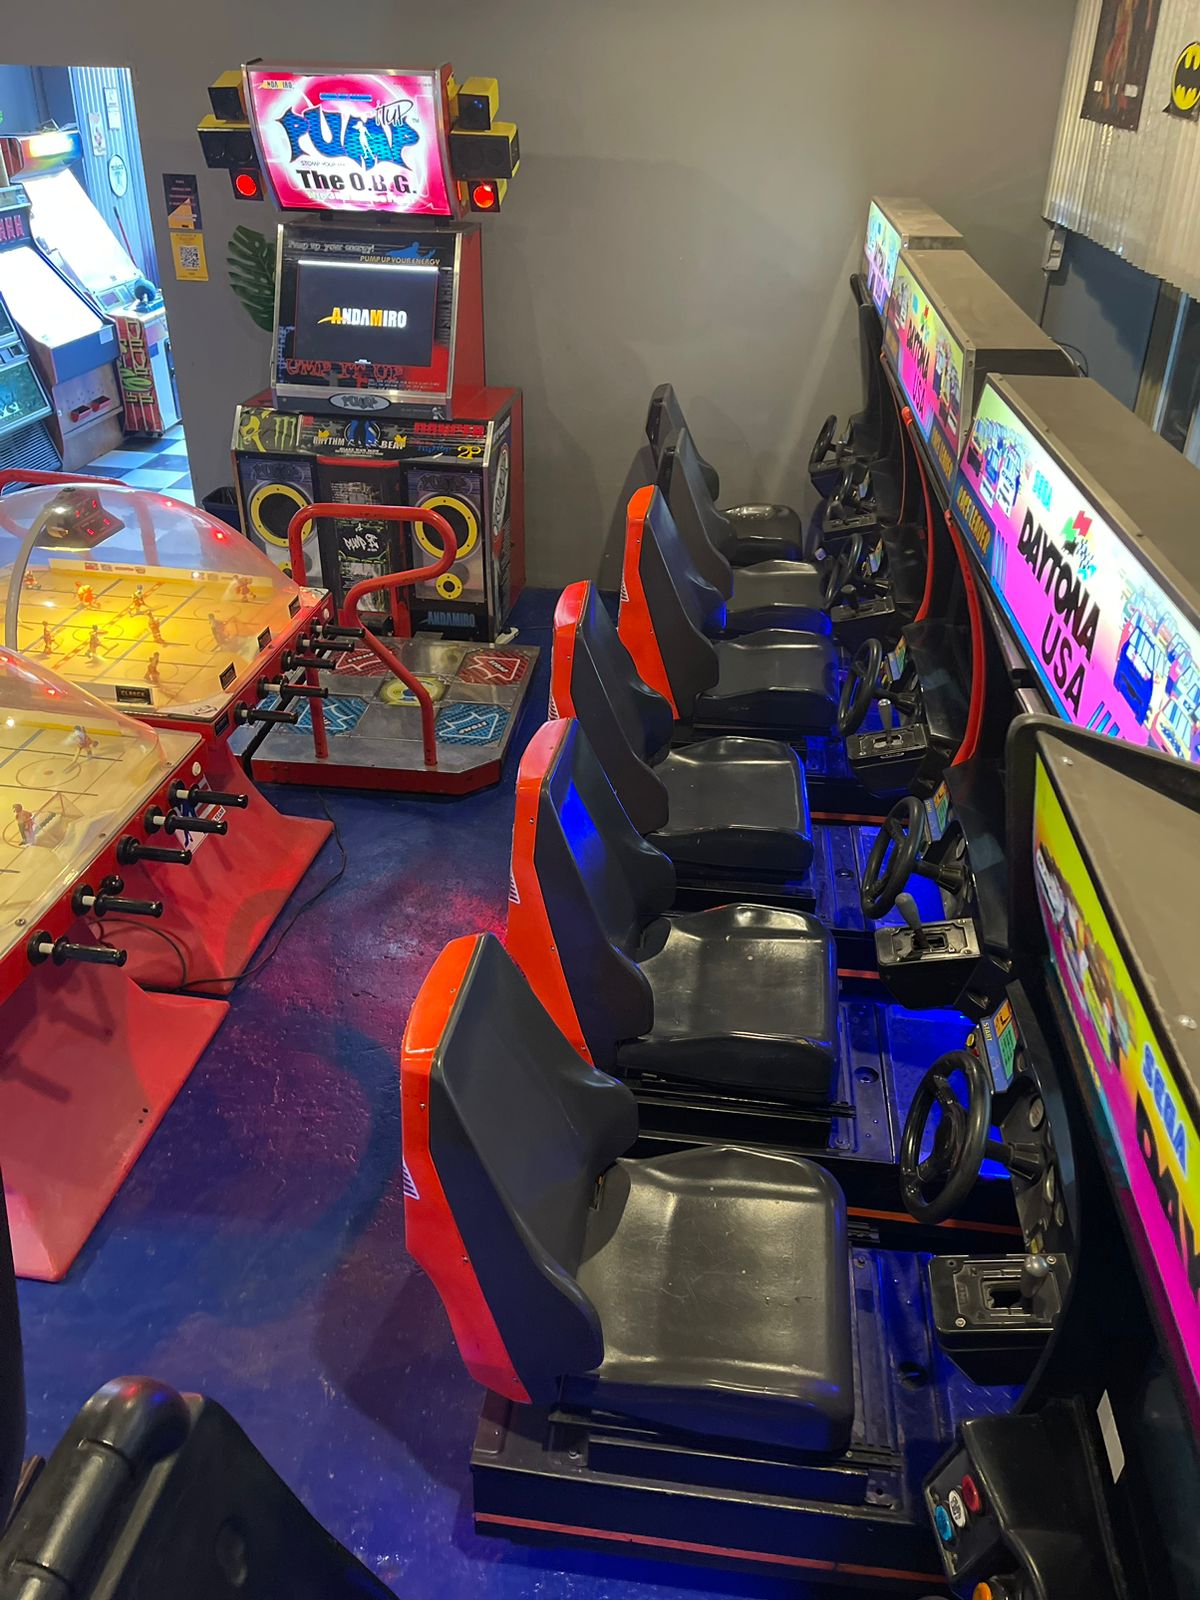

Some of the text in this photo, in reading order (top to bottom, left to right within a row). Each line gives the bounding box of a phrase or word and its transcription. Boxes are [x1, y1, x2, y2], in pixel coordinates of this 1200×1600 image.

[275, 105, 420, 171] PUMP
[296, 169, 346, 191] The
[360, 255, 380, 263] PUMP
[329, 307, 407, 328] ANDAMIRO
[457, 445, 481, 460] 2P
[1017, 506, 1101, 664] DAYTONA
[427, 611, 475, 628] ANDAMIRO
[1042, 613, 1087, 719] USA
[1142, 1042, 1187, 1178] SEGA
